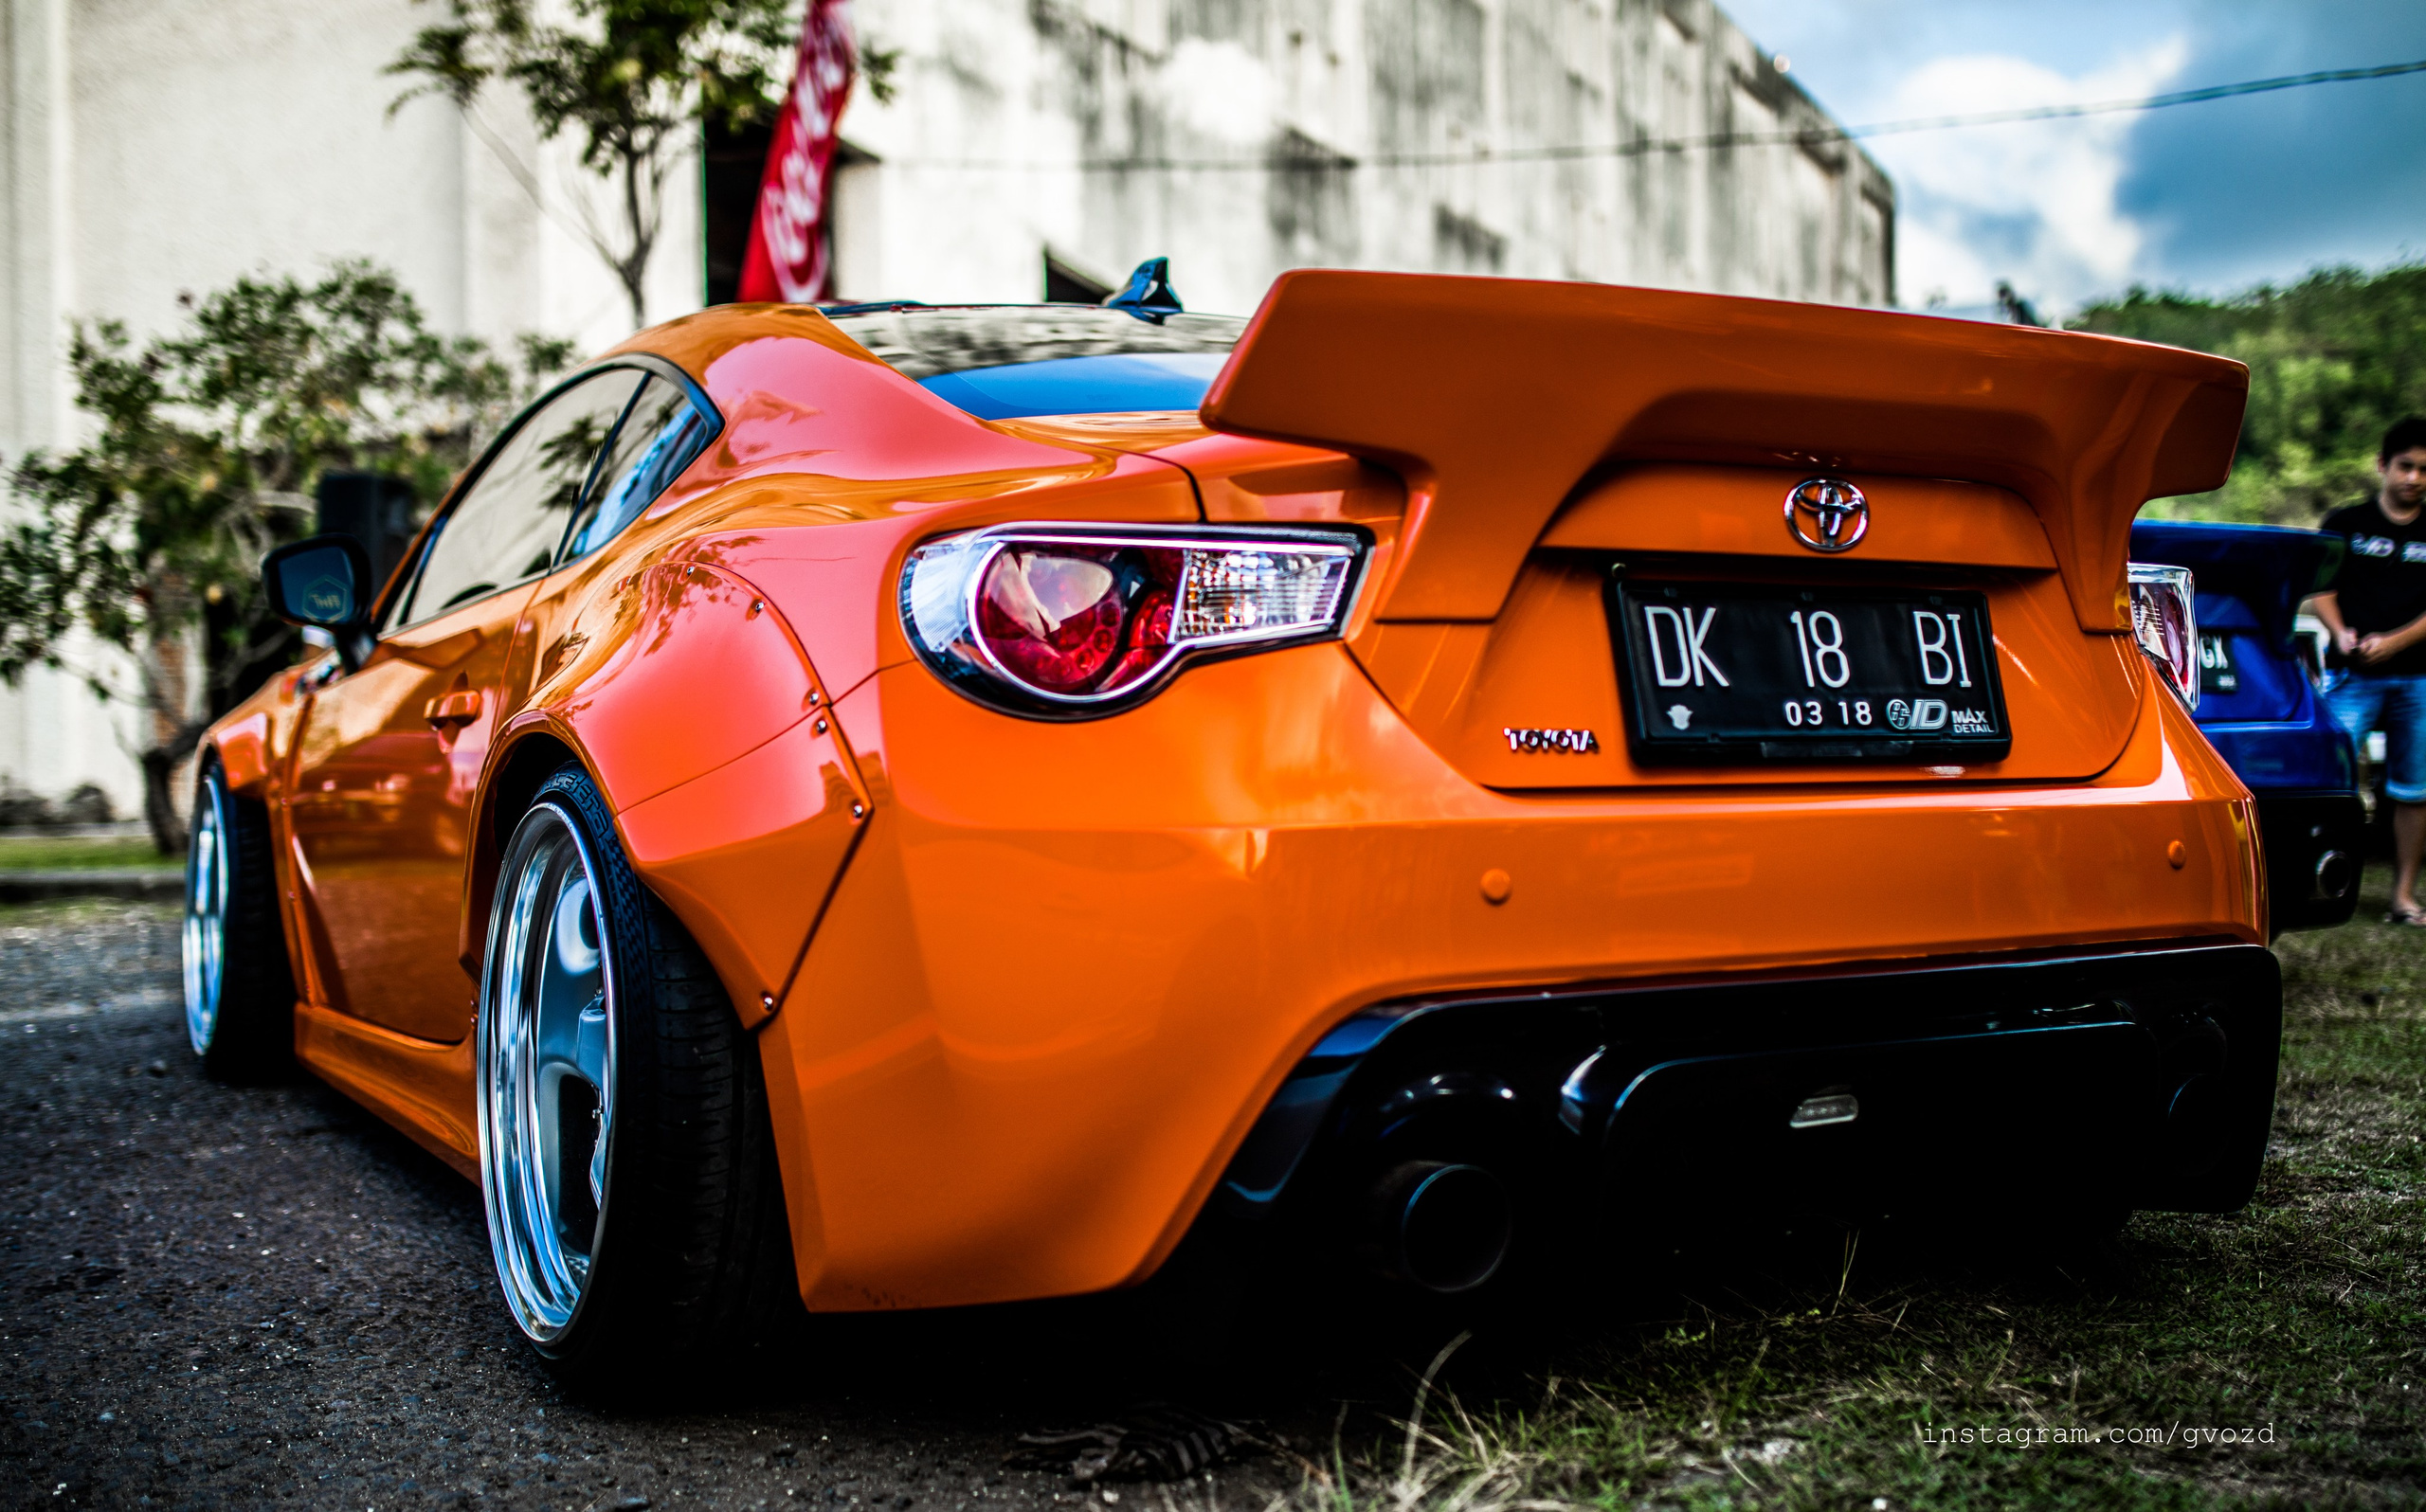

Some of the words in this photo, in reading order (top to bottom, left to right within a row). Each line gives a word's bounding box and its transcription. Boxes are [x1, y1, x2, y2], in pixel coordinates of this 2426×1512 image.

[1644, 605, 1730, 688] DK
[1790, 610, 1851, 688] 18
[1912, 610, 1972, 688] BI
[1784, 701, 1823, 727] 03
[1838, 701, 1873, 727] 18
[1950, 707, 1988, 724] MAX
[1503, 728, 1600, 754] TOYOTA
[1953, 724, 1995, 733] DETAIL
